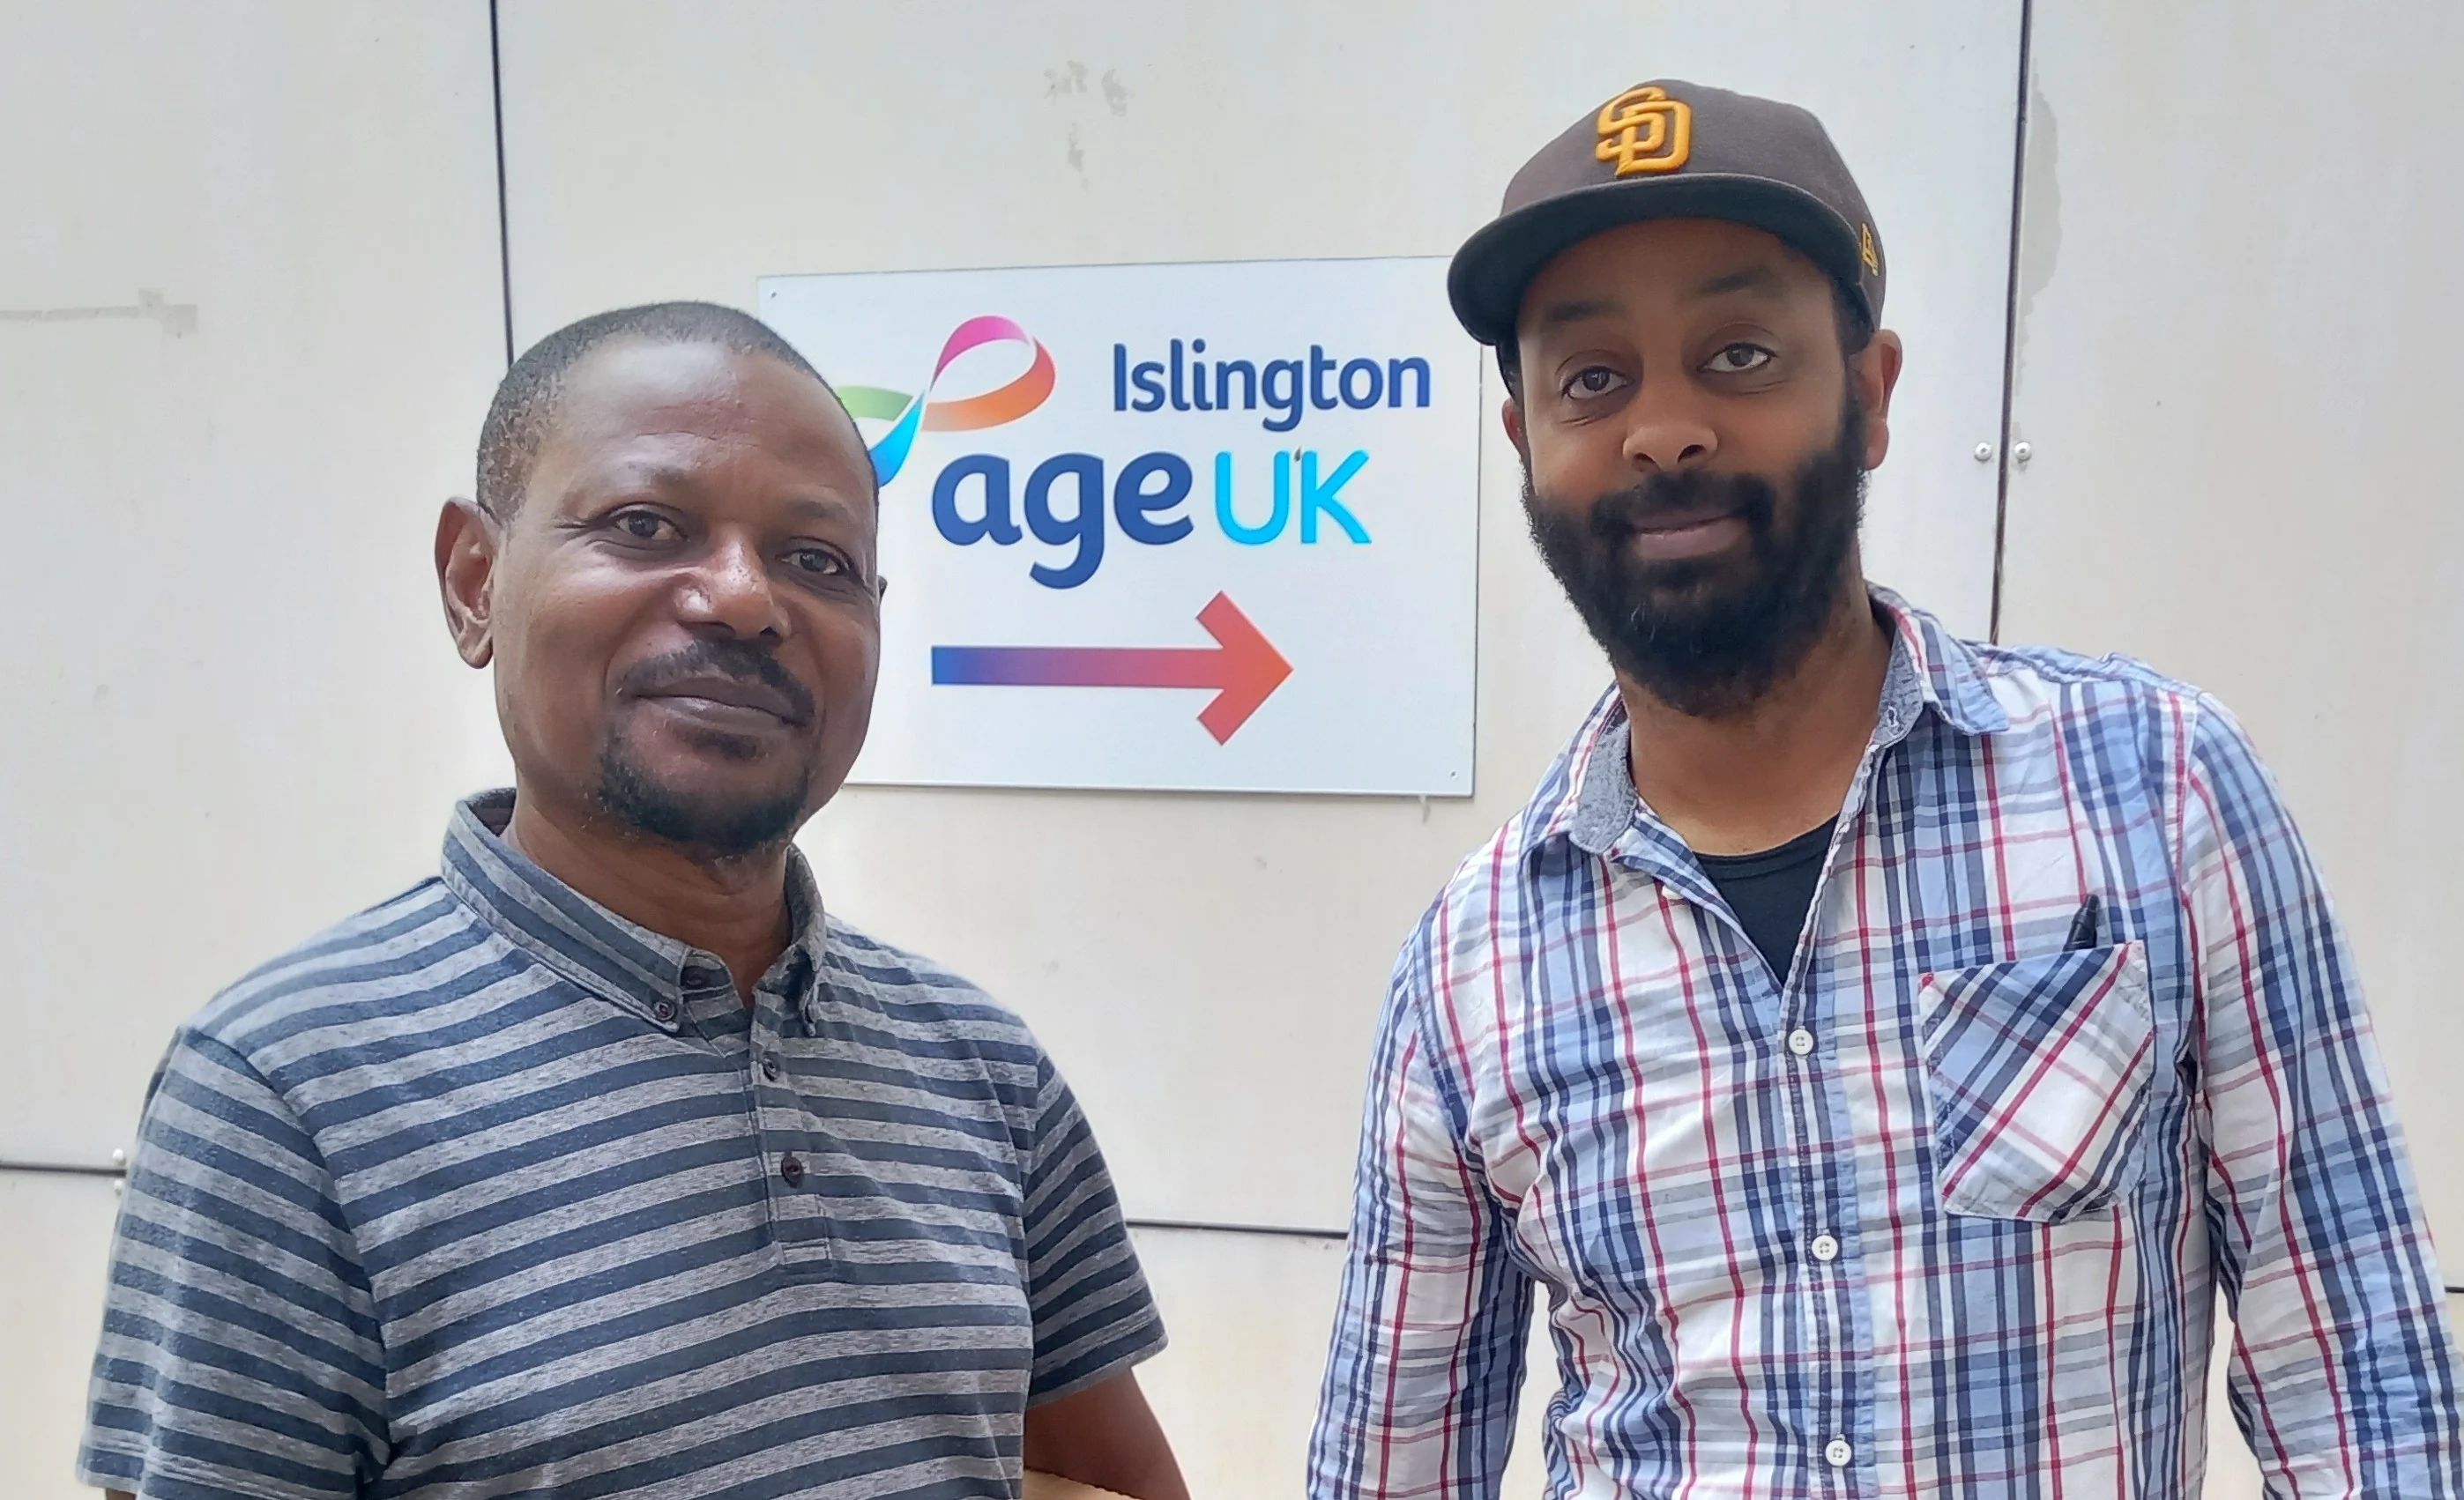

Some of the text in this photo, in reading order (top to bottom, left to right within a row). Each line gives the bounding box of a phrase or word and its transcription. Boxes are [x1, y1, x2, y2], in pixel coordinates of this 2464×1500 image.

[1596, 86, 1692, 177] SD
[1113, 338, 1432, 433] Islington
[931, 449, 1373, 590] age UK
